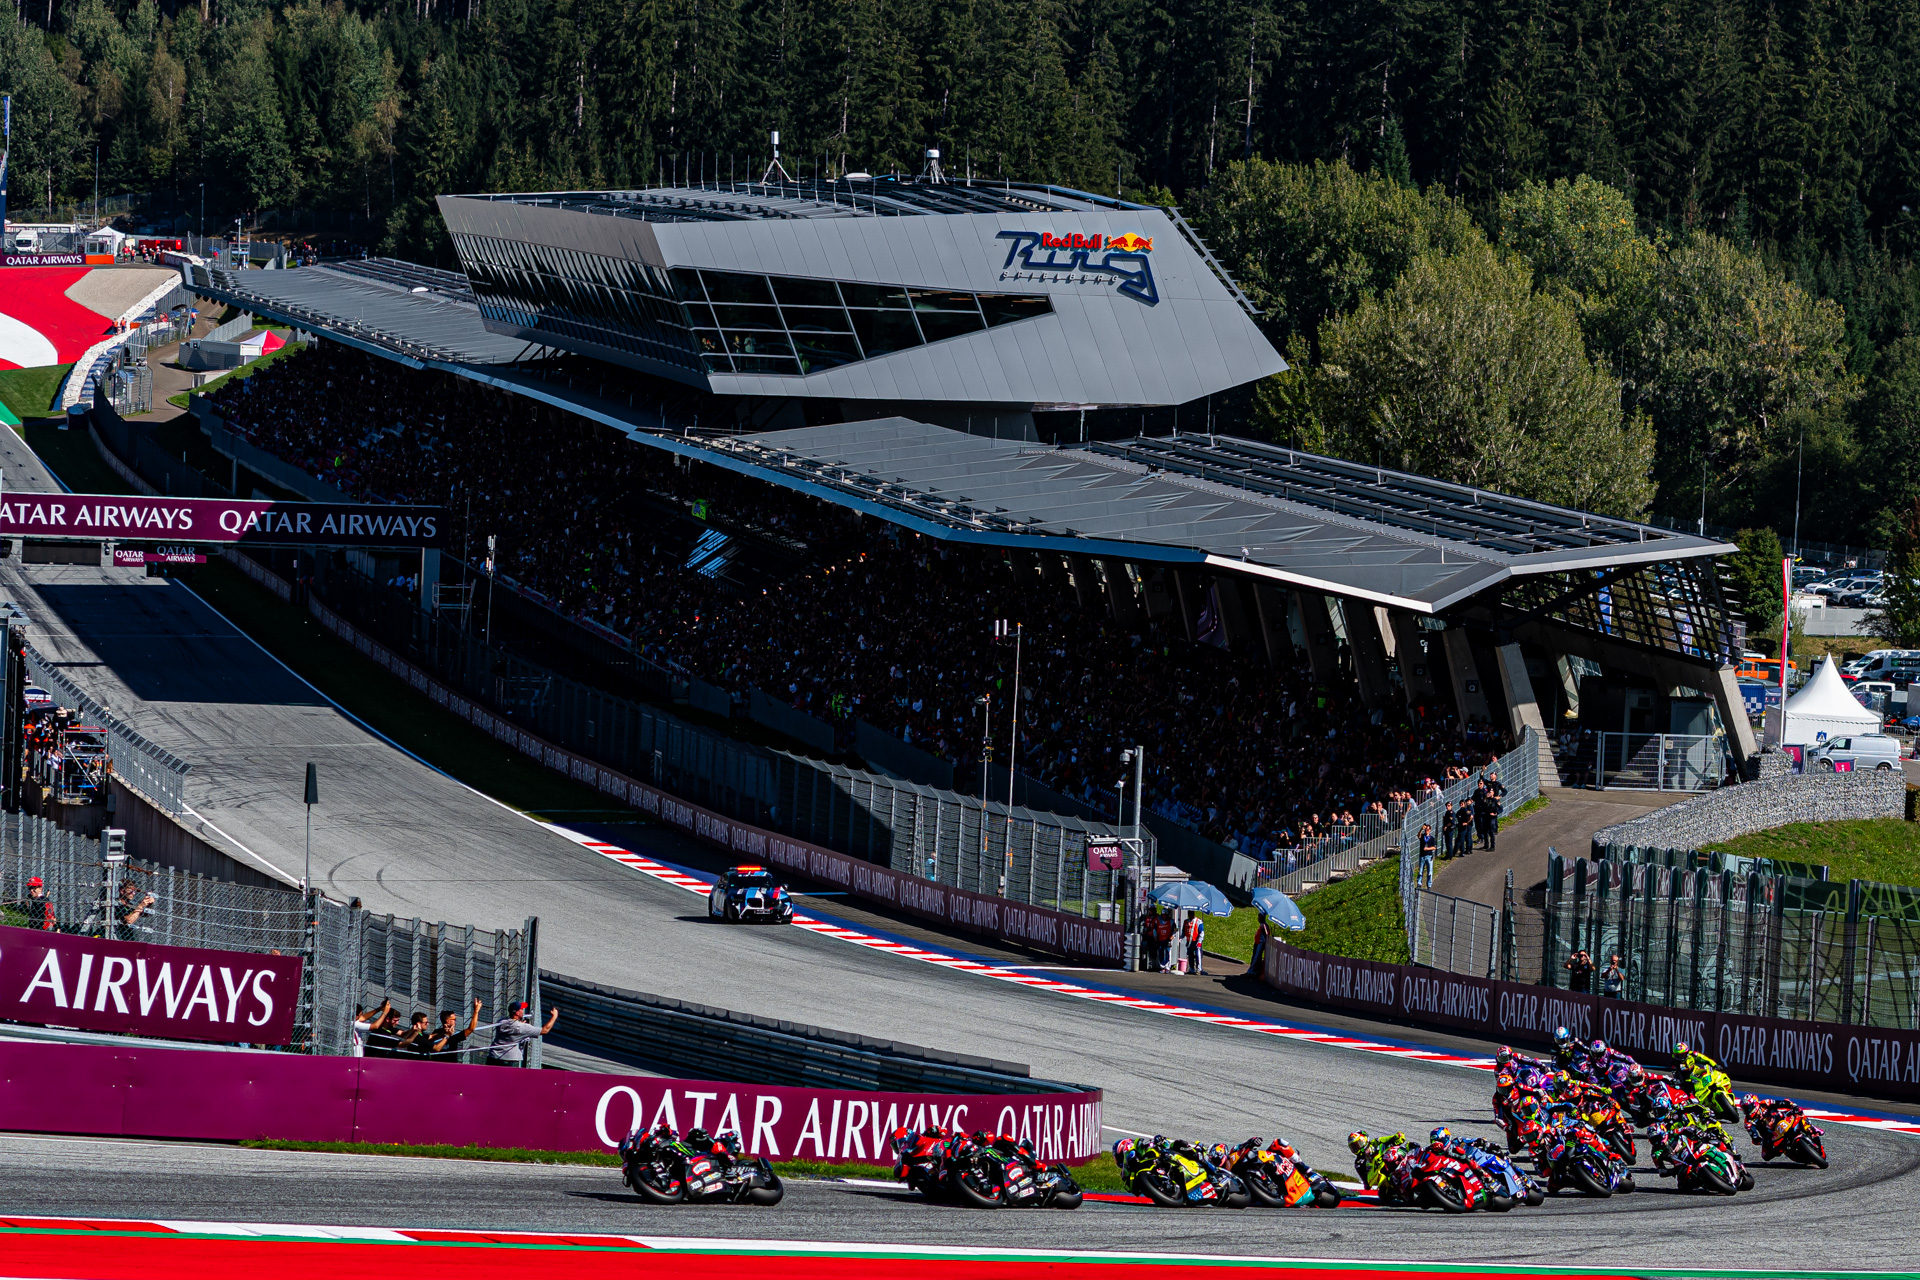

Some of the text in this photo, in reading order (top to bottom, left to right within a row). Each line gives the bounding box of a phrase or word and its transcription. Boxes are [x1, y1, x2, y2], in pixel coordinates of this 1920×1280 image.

[1042, 232, 1102, 249] Red Bull
[6, 255, 82, 266] QATAR AIRWAYS
[73, 504, 193, 530] AIRWAYS
[219, 509, 437, 538] QATAR AIRWAYS
[115, 550, 144, 559] QATAR
[156, 545, 196, 557] QATAR
[166, 554, 196, 563] AIRWAYS
[853, 865, 871, 893] QATAR
[900, 880, 945, 916] QATAR AIRWAYS
[949, 894, 998, 930] QATAR AIRWAYS
[1003, 906, 1057, 945] QATAR AIRWAYS
[1062, 921, 1120, 960] QATAR AIRWAYS
[19, 948, 276, 1027] AIRWAYS
[1293, 955, 1320, 992] AIRWAYS
[1325, 963, 1395, 1006] QATAR AIRWAYS
[1402, 976, 1489, 1023] QATAR AIRWAYS
[1500, 991, 1537, 1030] QATAR
[1603, 1007, 1645, 1049] QATAR
[1719, 1023, 1833, 1074] QATAR AIRWAYS
[1847, 1036, 1900, 1083] QATAR
[595, 1085, 780, 1156] QATAR
[1776, 1121, 1789, 1134] 23
